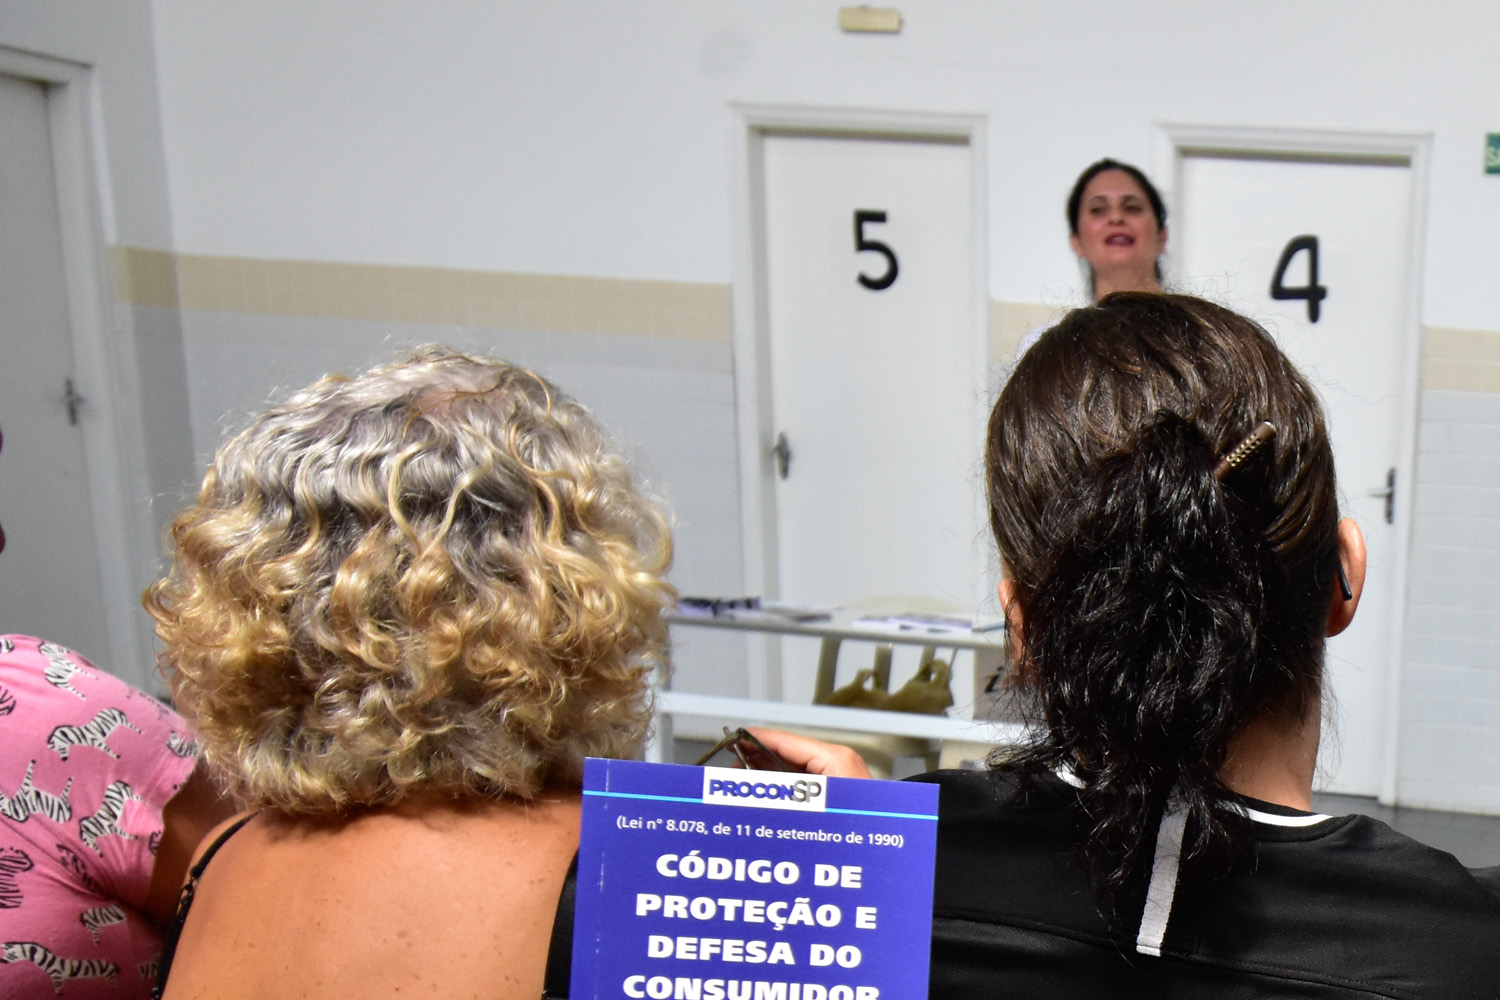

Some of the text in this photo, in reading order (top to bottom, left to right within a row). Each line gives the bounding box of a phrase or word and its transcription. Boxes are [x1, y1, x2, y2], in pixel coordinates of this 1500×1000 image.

[853, 209, 899, 291] 5
[1270, 234, 1328, 324] 4
[617, 815, 642, 829] (Lei
[666, 819, 708, 835] 8.078,
[713, 823, 731, 835] de
[736, 825, 750, 836] 11
[755, 826, 773, 838] de
[777, 829, 842, 842] setembro
[845, 832, 863, 844] de
[868, 833, 904, 848] 1990)
[656, 850, 862, 888] CÓDIGO DE
[636, 893, 877, 931] PROTEÇÃO E
[648, 935, 862, 968] DEFESA DO
